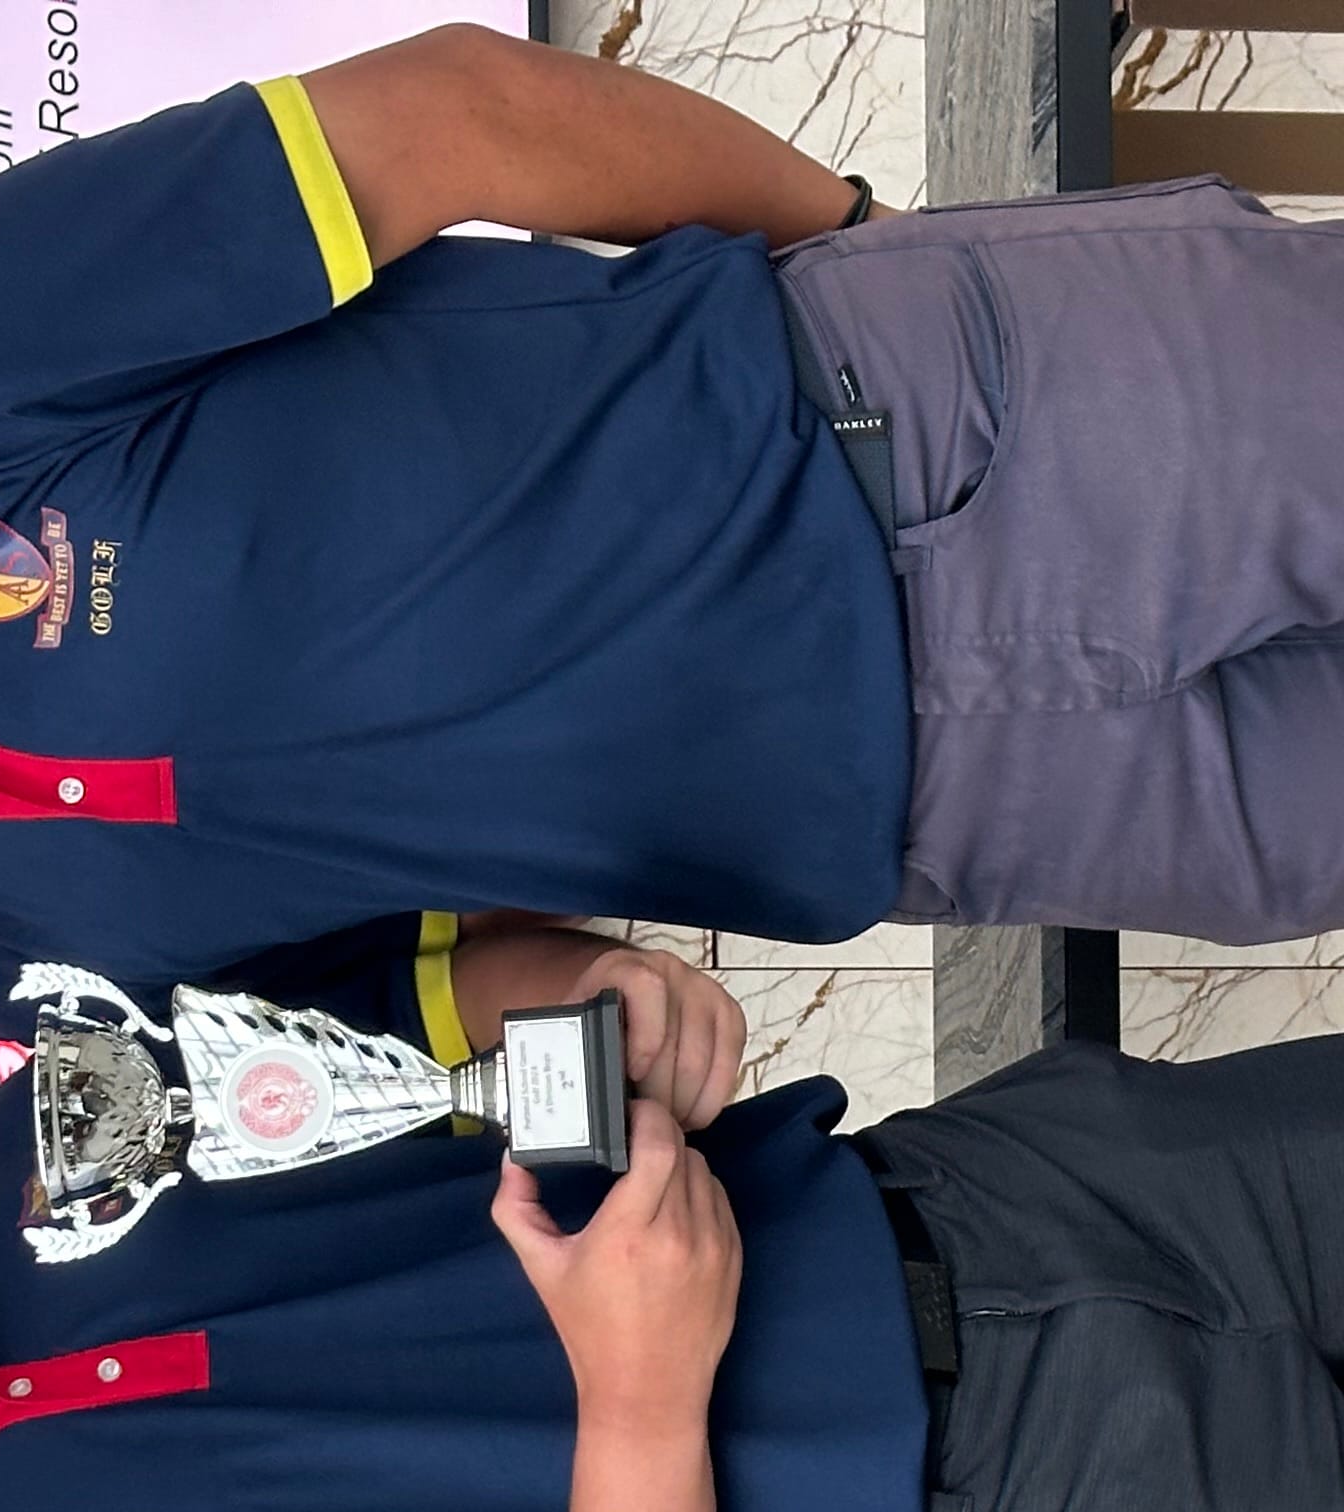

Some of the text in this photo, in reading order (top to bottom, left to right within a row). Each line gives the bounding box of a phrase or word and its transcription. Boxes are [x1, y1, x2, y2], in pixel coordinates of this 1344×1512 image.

[38, 0, 79, 139] Reso
[42, 521, 69, 641] THE BEST IS YET TO BE
[89, 538, 123, 635] GOLF
